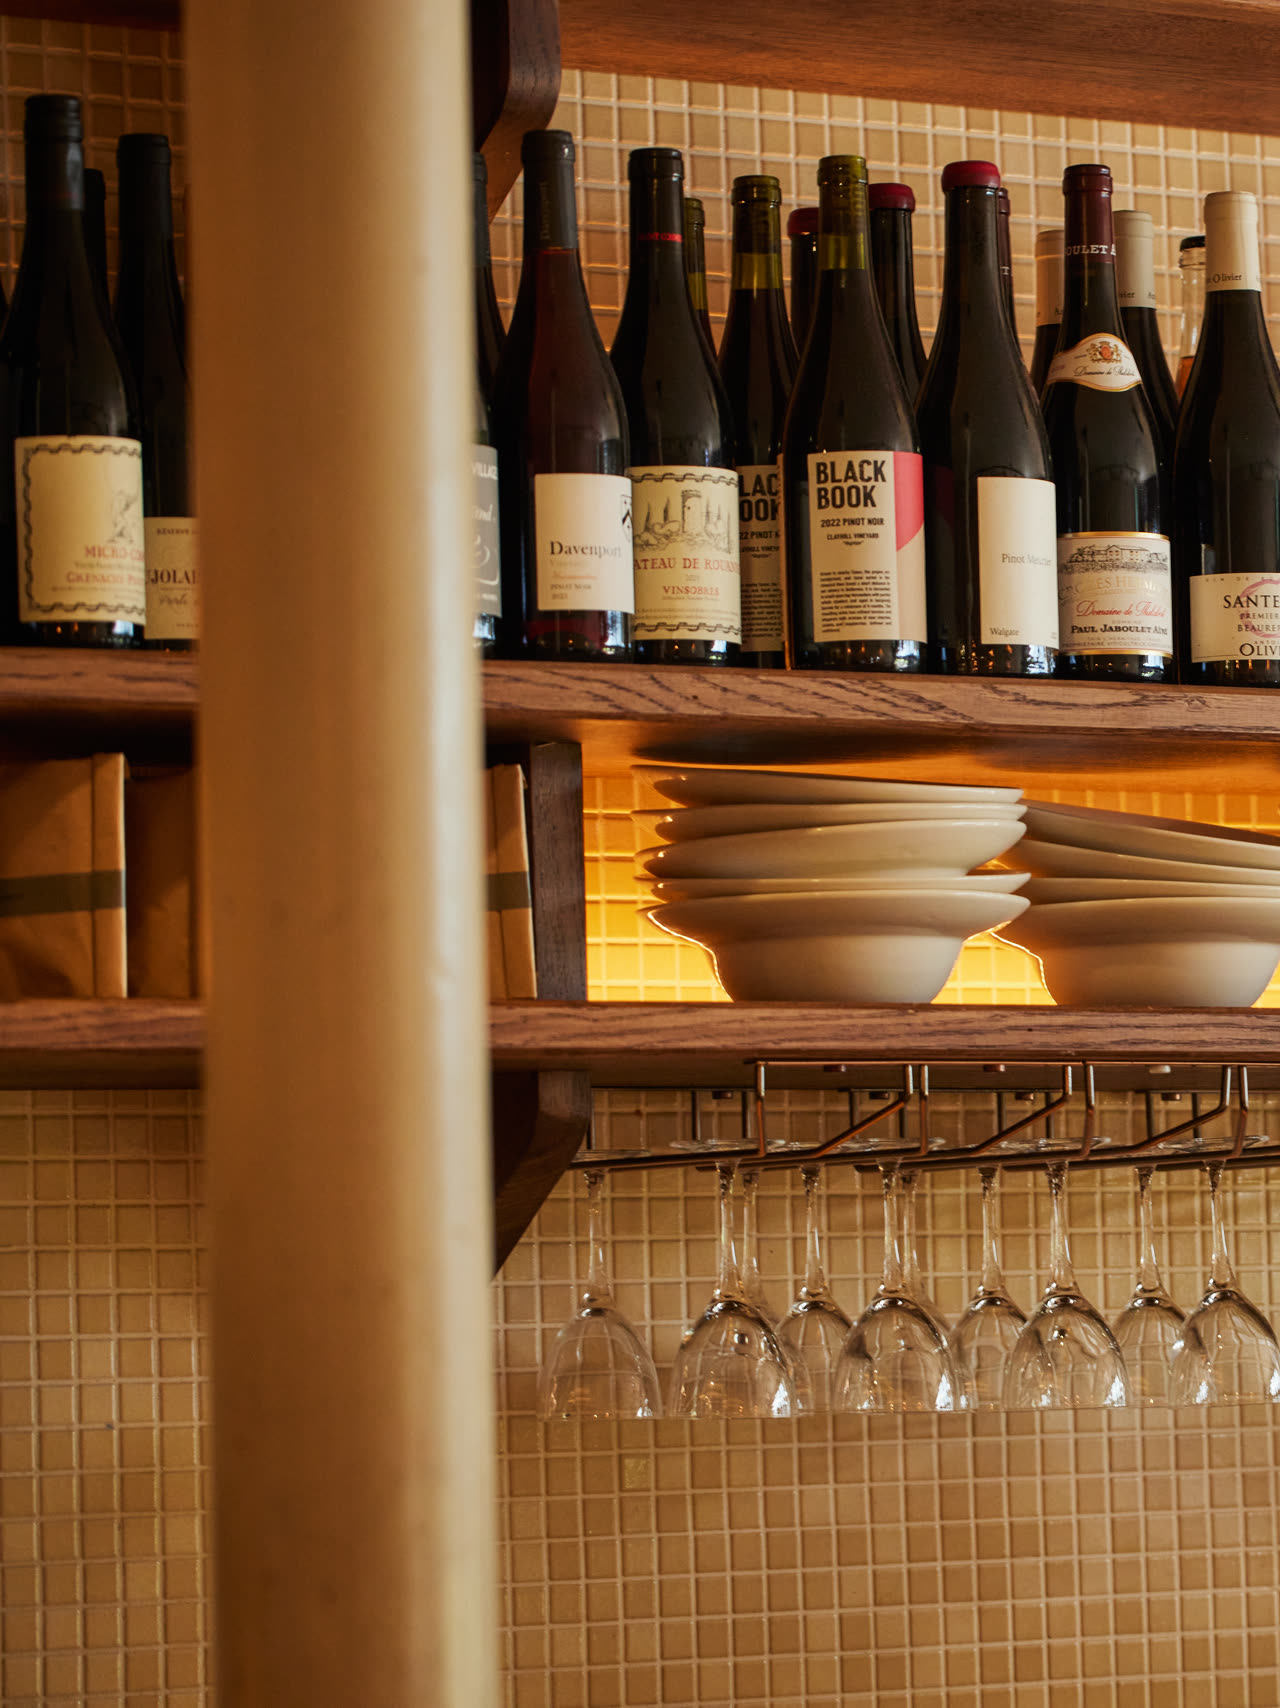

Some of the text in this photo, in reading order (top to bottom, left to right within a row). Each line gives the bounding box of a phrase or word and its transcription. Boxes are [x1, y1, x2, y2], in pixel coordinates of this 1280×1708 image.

[815, 459, 887, 485] BLACK
[816, 484, 877, 510] BOOK
[821, 517, 885, 528] 2022 PINOT NOIR
[549, 540, 623, 559] Davenport
[682, 557, 699, 570] DE
[1001, 552, 1025, 565] Pinot
[662, 585, 720, 596] VINSOBRES
[1076, 599, 1122, 617] Domaine
[1123, 603, 1134, 616] de
[1239, 612, 1279, 620] PREMIER
[989, 626, 1020, 637] Walgate
